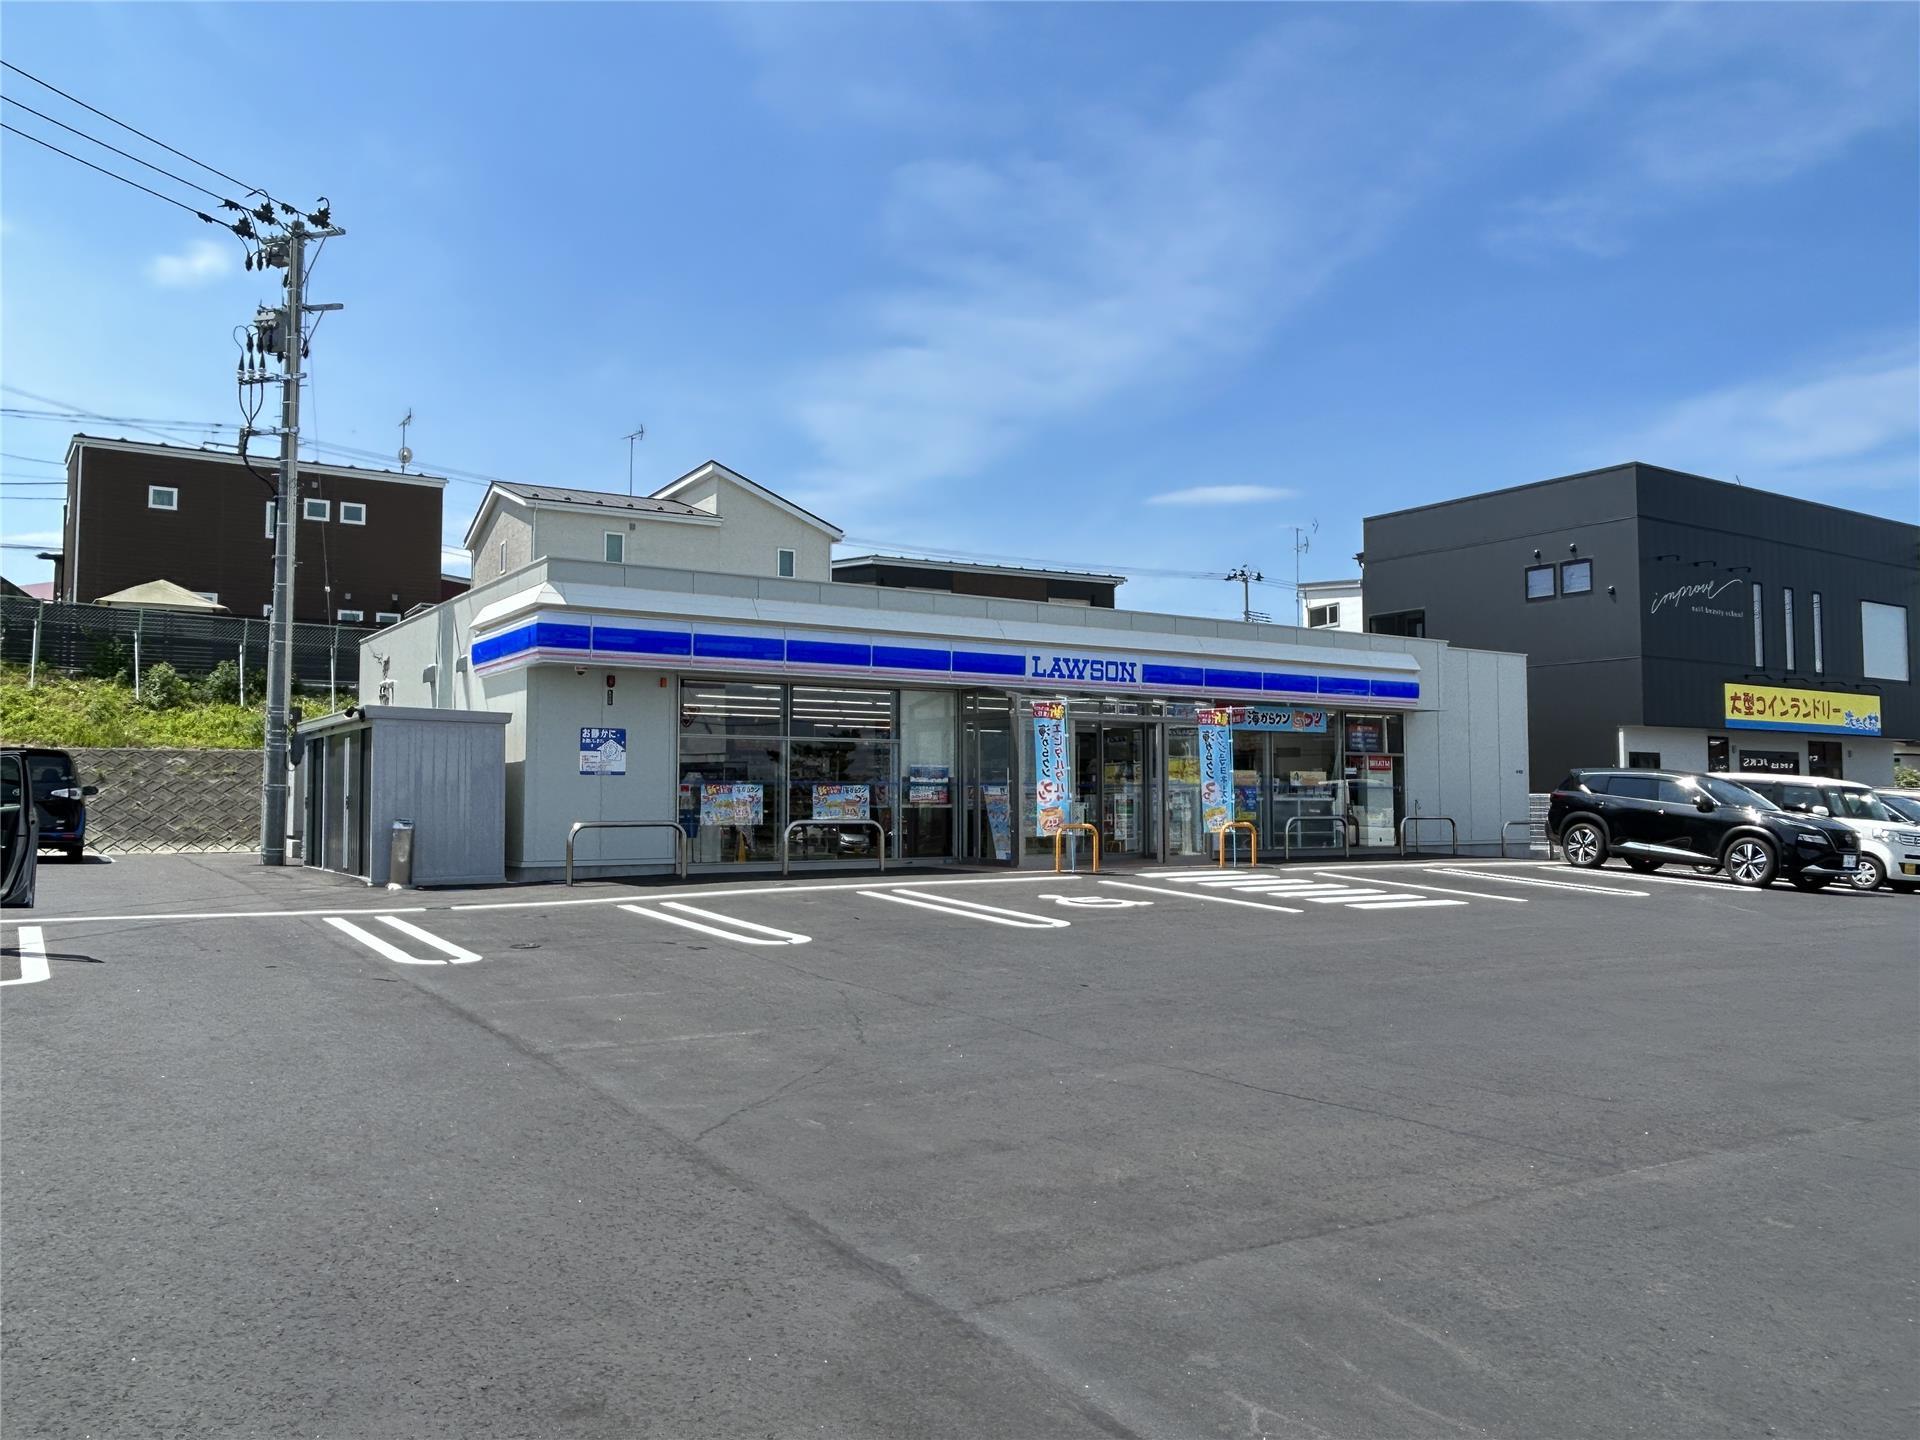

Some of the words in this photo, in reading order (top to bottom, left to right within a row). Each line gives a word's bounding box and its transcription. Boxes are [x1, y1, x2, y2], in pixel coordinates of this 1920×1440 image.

[1651, 579, 1743, 614] improve
[1032, 656, 1137, 682] LAWSON
[1247, 711, 1290, 726] 海からクン
[1730, 691, 1841, 719] 大型コインランドリー
